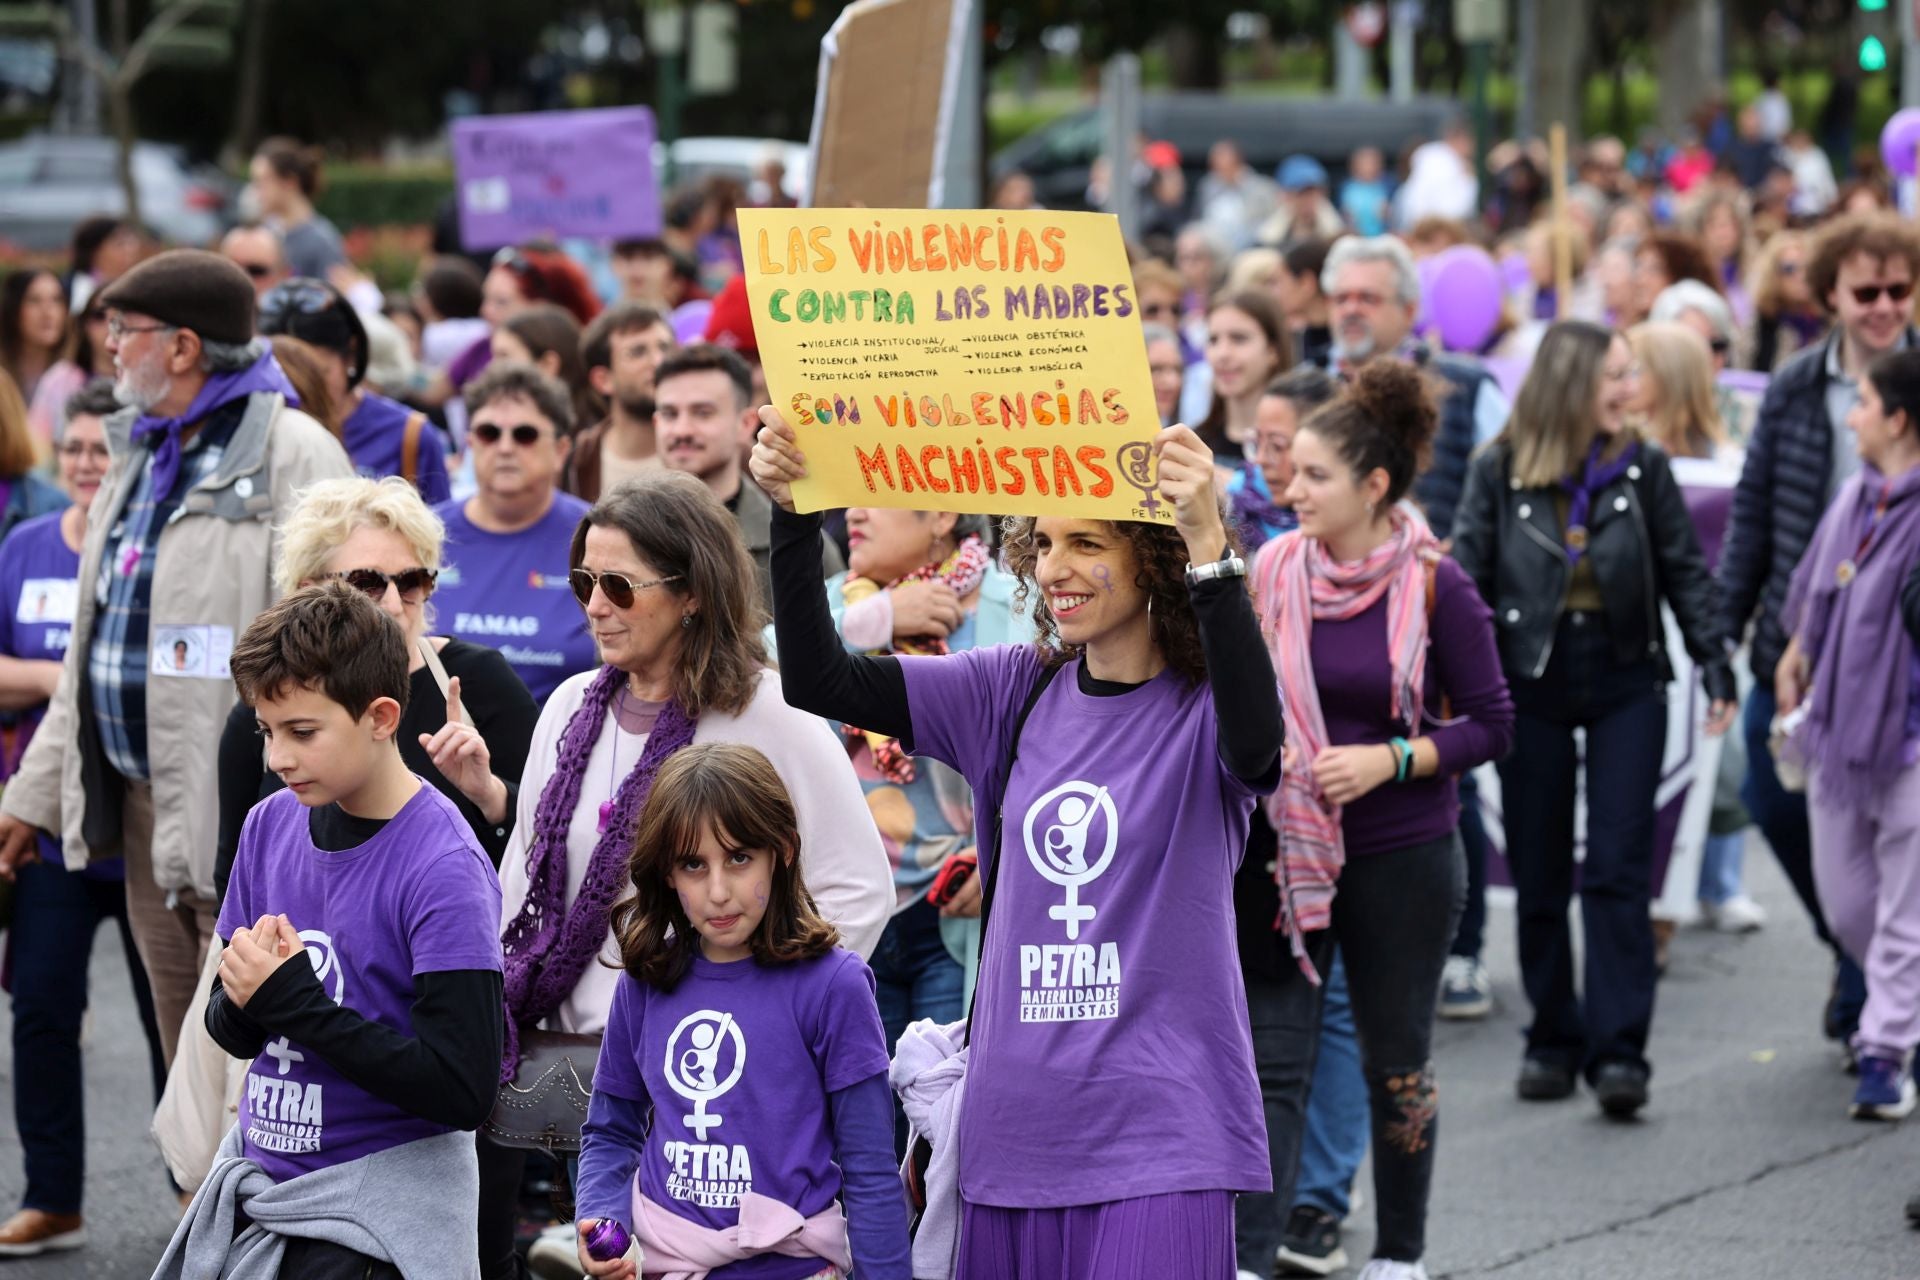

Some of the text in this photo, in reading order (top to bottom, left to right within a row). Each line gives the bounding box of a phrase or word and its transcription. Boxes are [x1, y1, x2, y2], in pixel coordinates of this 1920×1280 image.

[758, 226, 836, 275] LAS
[769, 283, 1133, 324] CONTRA LAS MADRES
[808, 338, 859, 348] VIOLENCIA
[972, 329, 1085, 342] VIOLENCIA OBSTÉTRICA
[809, 354, 899, 365] VIOLENCIA VICARIA
[925, 345, 959, 354] JUDICIAL
[975, 345, 1088, 359] VIOLENCIA ECONÓMICA
[810, 371, 871, 381] EXPLOTACIÓN
[791, 392, 862, 426] SON
[454, 612, 539, 636] FAMAG
[1020, 942, 1121, 987] PETRA
[1021, 986, 1119, 1004] MATERNIDADES
[1023, 1003, 1116, 1019] FEMINISTAS
[248, 1072, 322, 1126] PETRA
[247, 1129, 318, 1151] FEMINISTAS
[664, 1141, 752, 1180] PETRA
